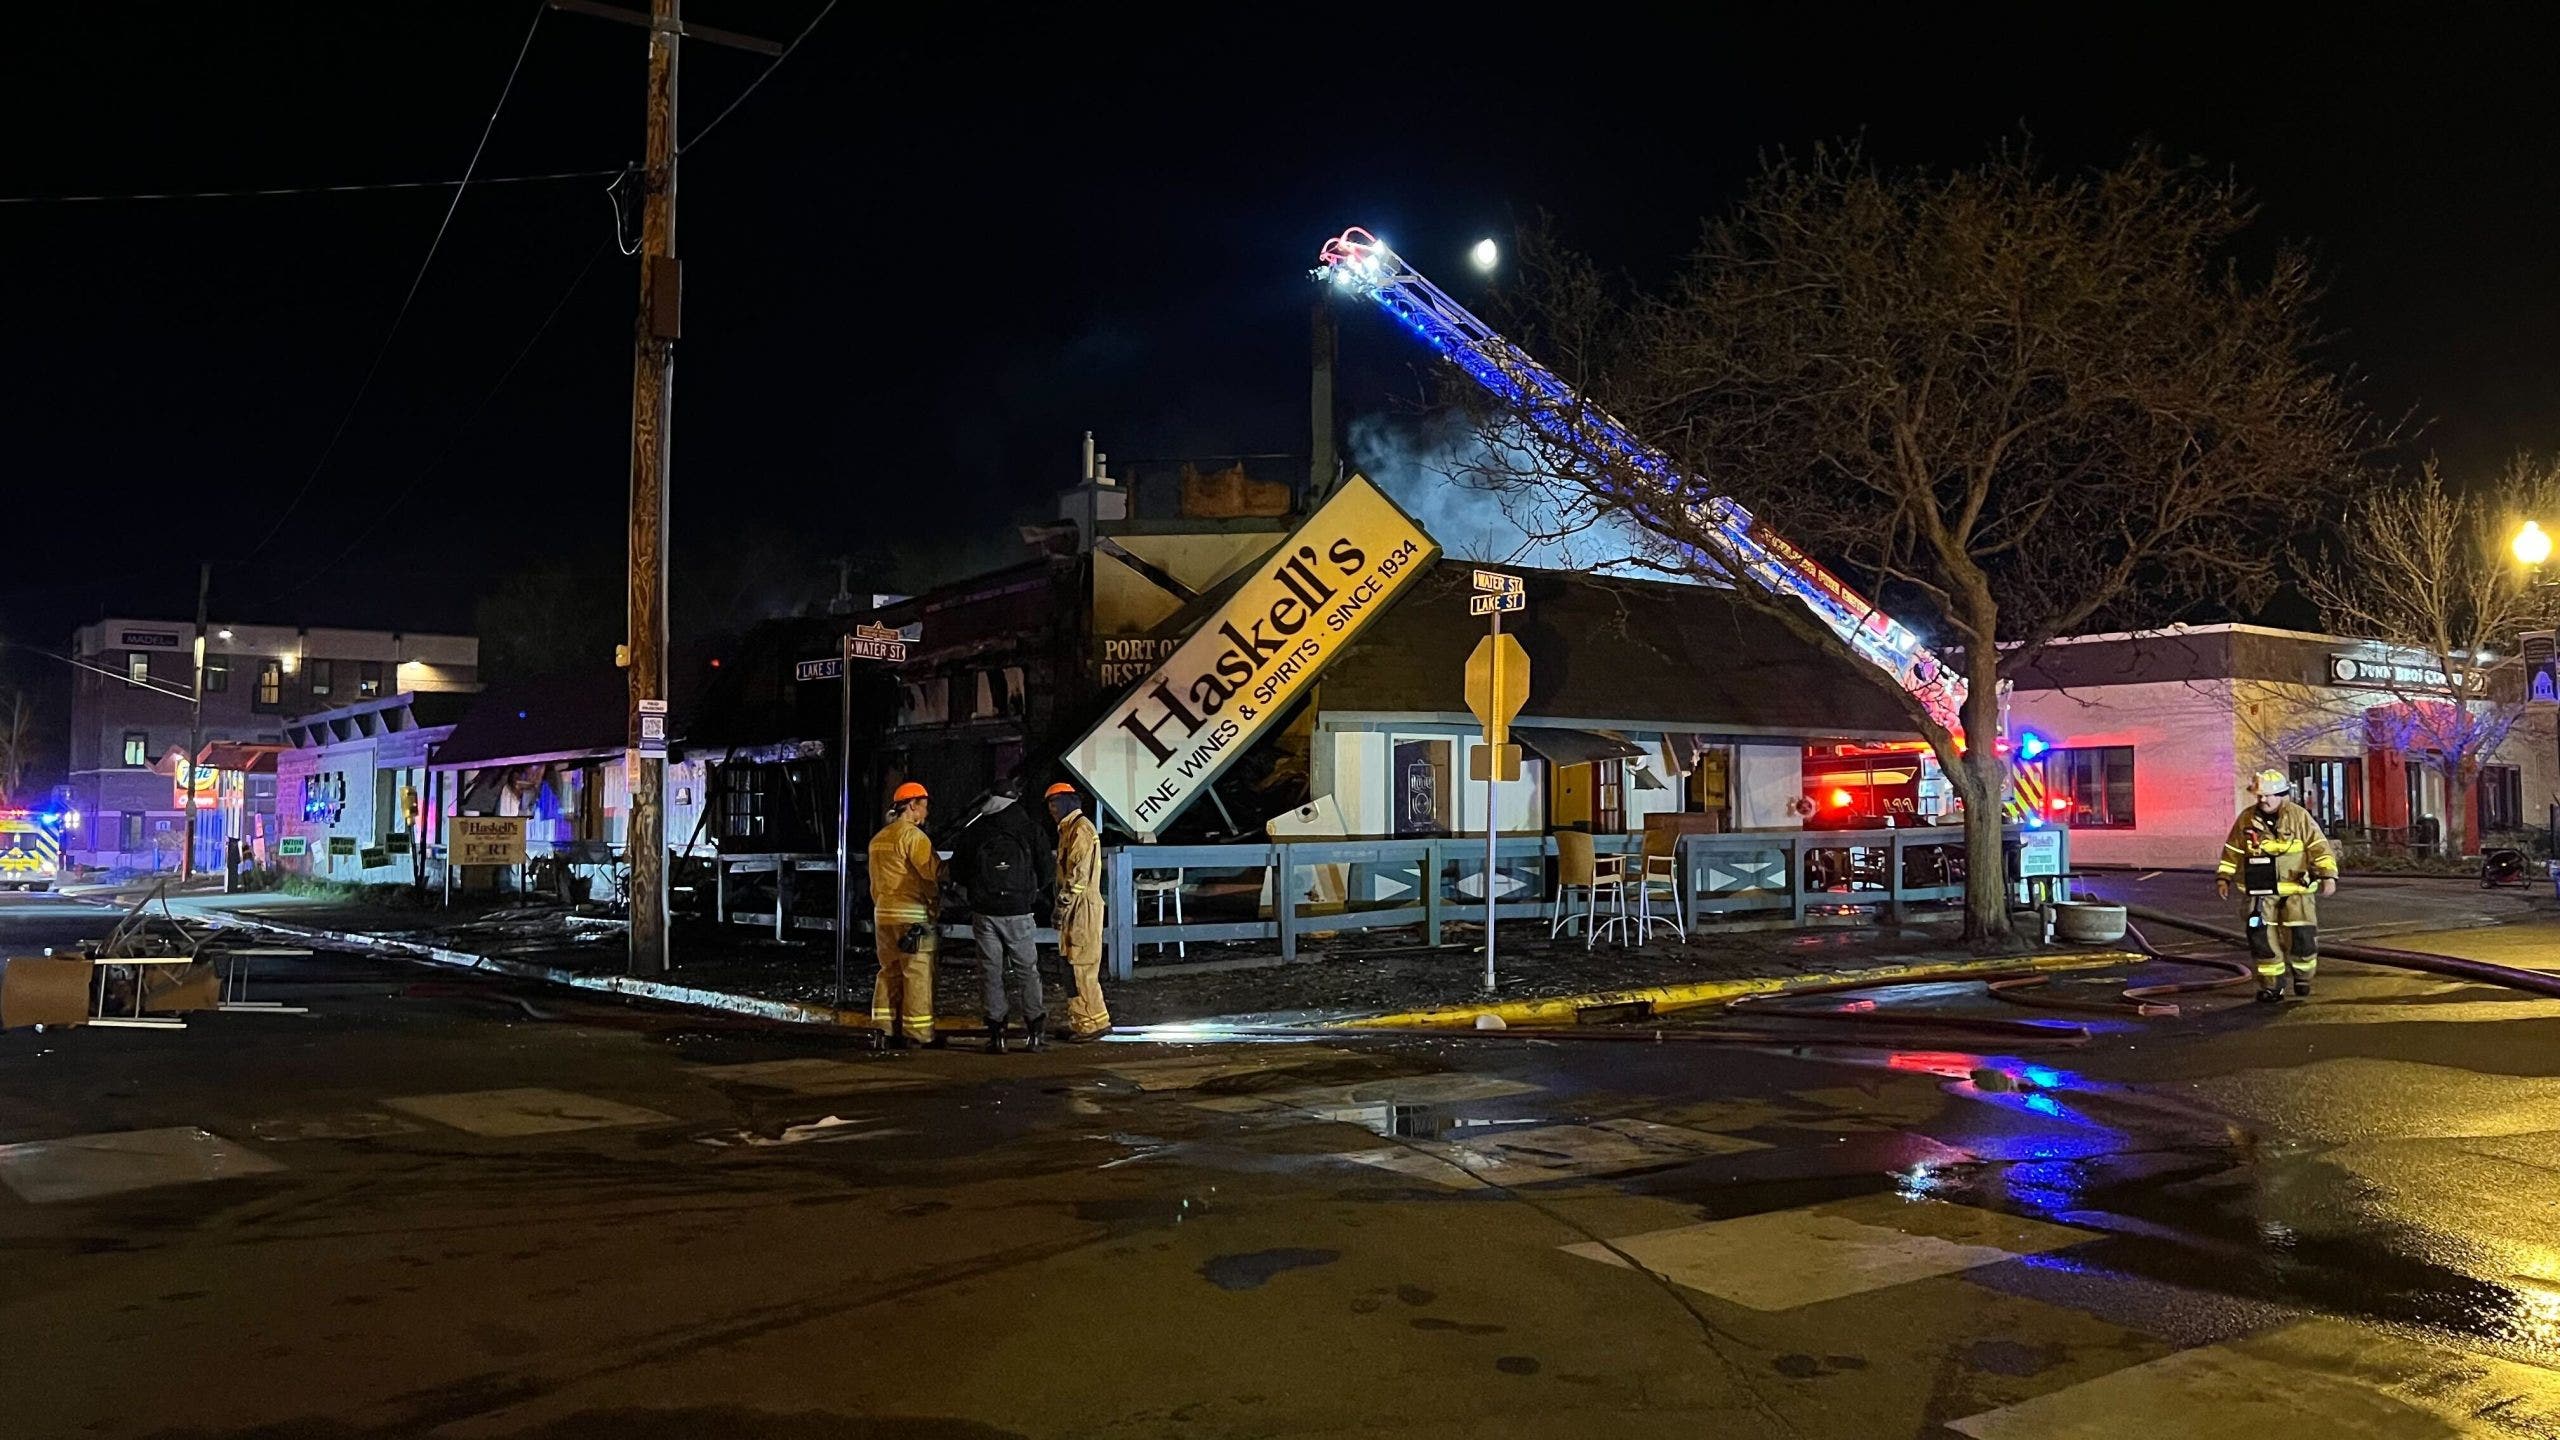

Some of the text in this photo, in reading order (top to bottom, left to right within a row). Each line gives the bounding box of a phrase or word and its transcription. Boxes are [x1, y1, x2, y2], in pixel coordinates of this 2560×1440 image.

[1477, 573, 1520, 592] WATER ST
[1477, 594, 1518, 611] LAKE ST
[855, 641, 901, 658] WATER ST
[1105, 640, 1155, 660] PORT
[1118, 538, 1365, 768] Haskell's
[803, 662, 836, 677] LAKE ST
[1135, 540, 1418, 822] FINE WINES & SPIRITS SINCE 1934
